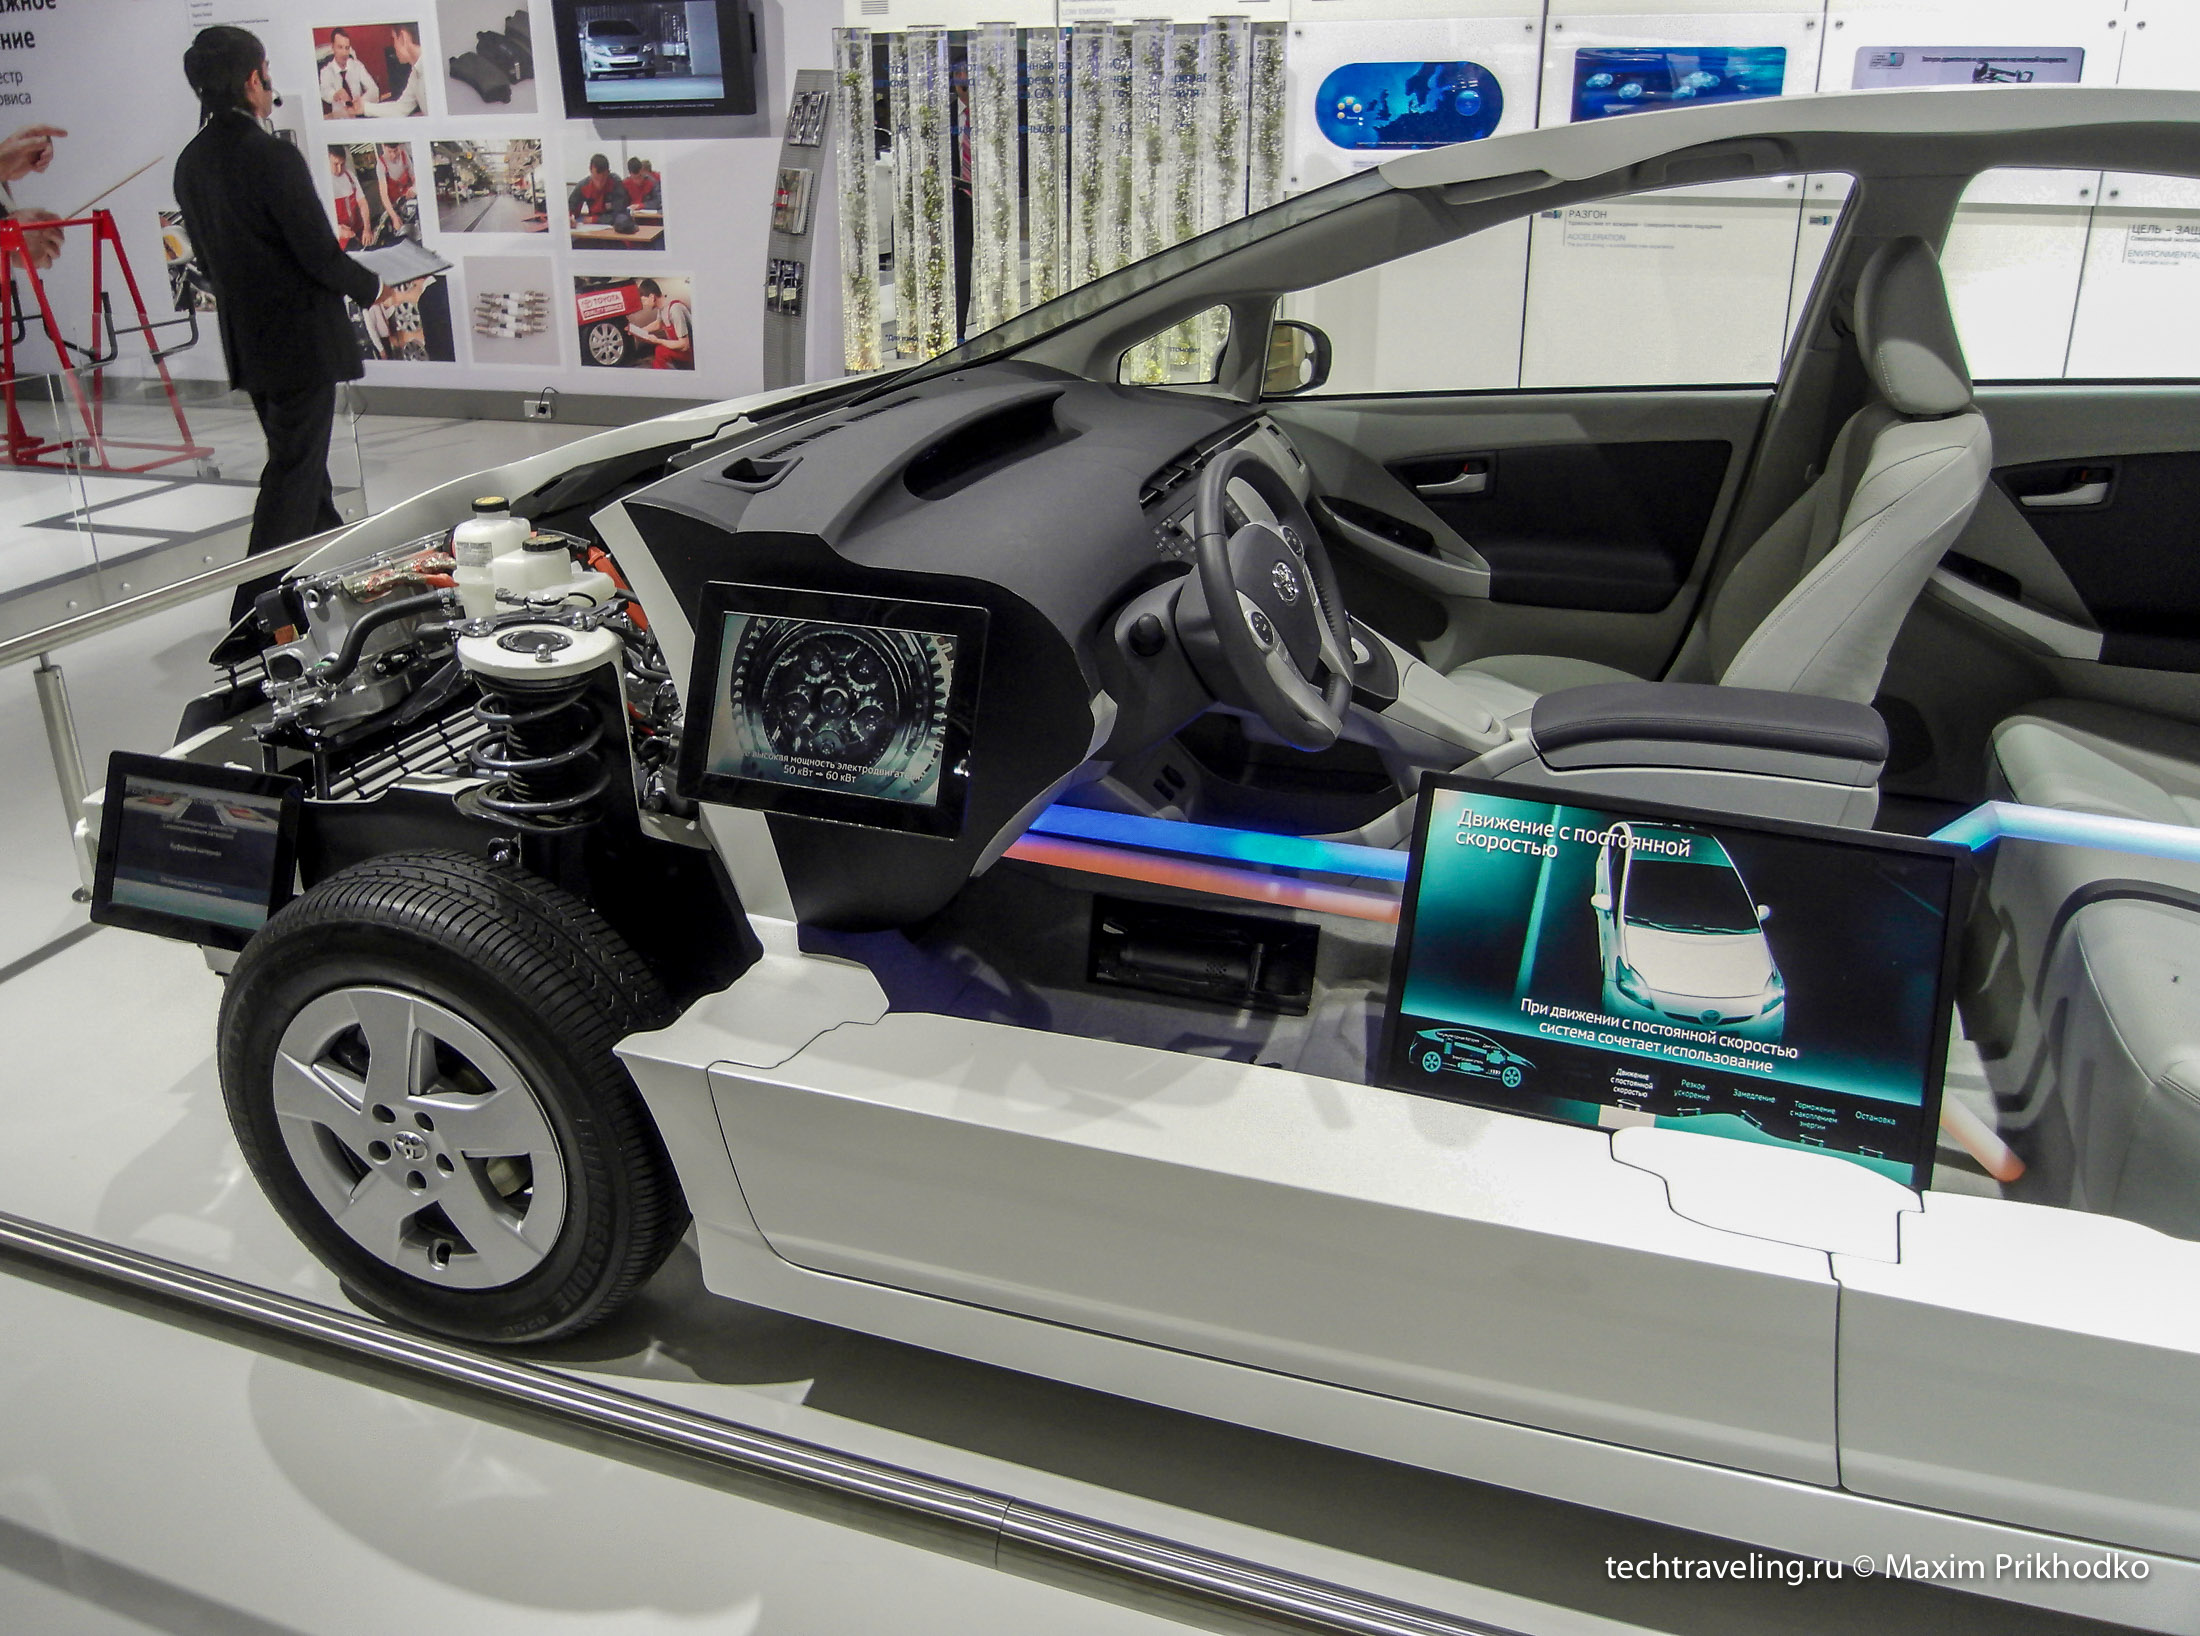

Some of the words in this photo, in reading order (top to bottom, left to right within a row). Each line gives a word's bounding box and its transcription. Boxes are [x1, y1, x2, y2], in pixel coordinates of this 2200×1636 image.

[1568, 209, 1607, 219] РАЗГОН
[2132, 224, 2162, 235] ЦЕЛЬ
[594, 294, 620, 305] TOYOTA
[790, 756, 835, 769] мощность
[784, 765, 795, 775] 50
[797, 767, 813, 778] кВт
[826, 770, 838, 781] 60
[840, 773, 856, 783] кВт
[1457, 808, 1554, 838] Движение
[1559, 826, 1571, 841] с
[1574, 828, 1691, 858] постоянной
[1456, 831, 1558, 858] скоростью
[1521, 998, 1549, 1016] При
[1550, 1005, 1620, 1028] движении
[1622, 1018, 1631, 1030] с
[1633, 1020, 1717, 1044] постоянной
[1719, 1034, 1798, 1059] скоростью
[1539, 1021, 1595, 1042] система
[1598, 1032, 1661, 1053] сочетает
[1663, 1043, 1773, 1073] использование
[1616, 1068, 1650, 1081] Движение
[1615, 1077, 1654, 1090] постоянной
[1681, 1079, 1706, 1091] Резкое
[1613, 1086, 1648, 1098] скоростью
[1673, 1089, 1711, 1101] ускорение
[1732, 1088, 1776, 1103] Замедление
[1794, 1100, 1836, 1114] Торможение
[1795, 1111, 1838, 1124] накоплением
[1855, 1111, 1897, 1125] Остановка
[1799, 1121, 1826, 1131] энергии
